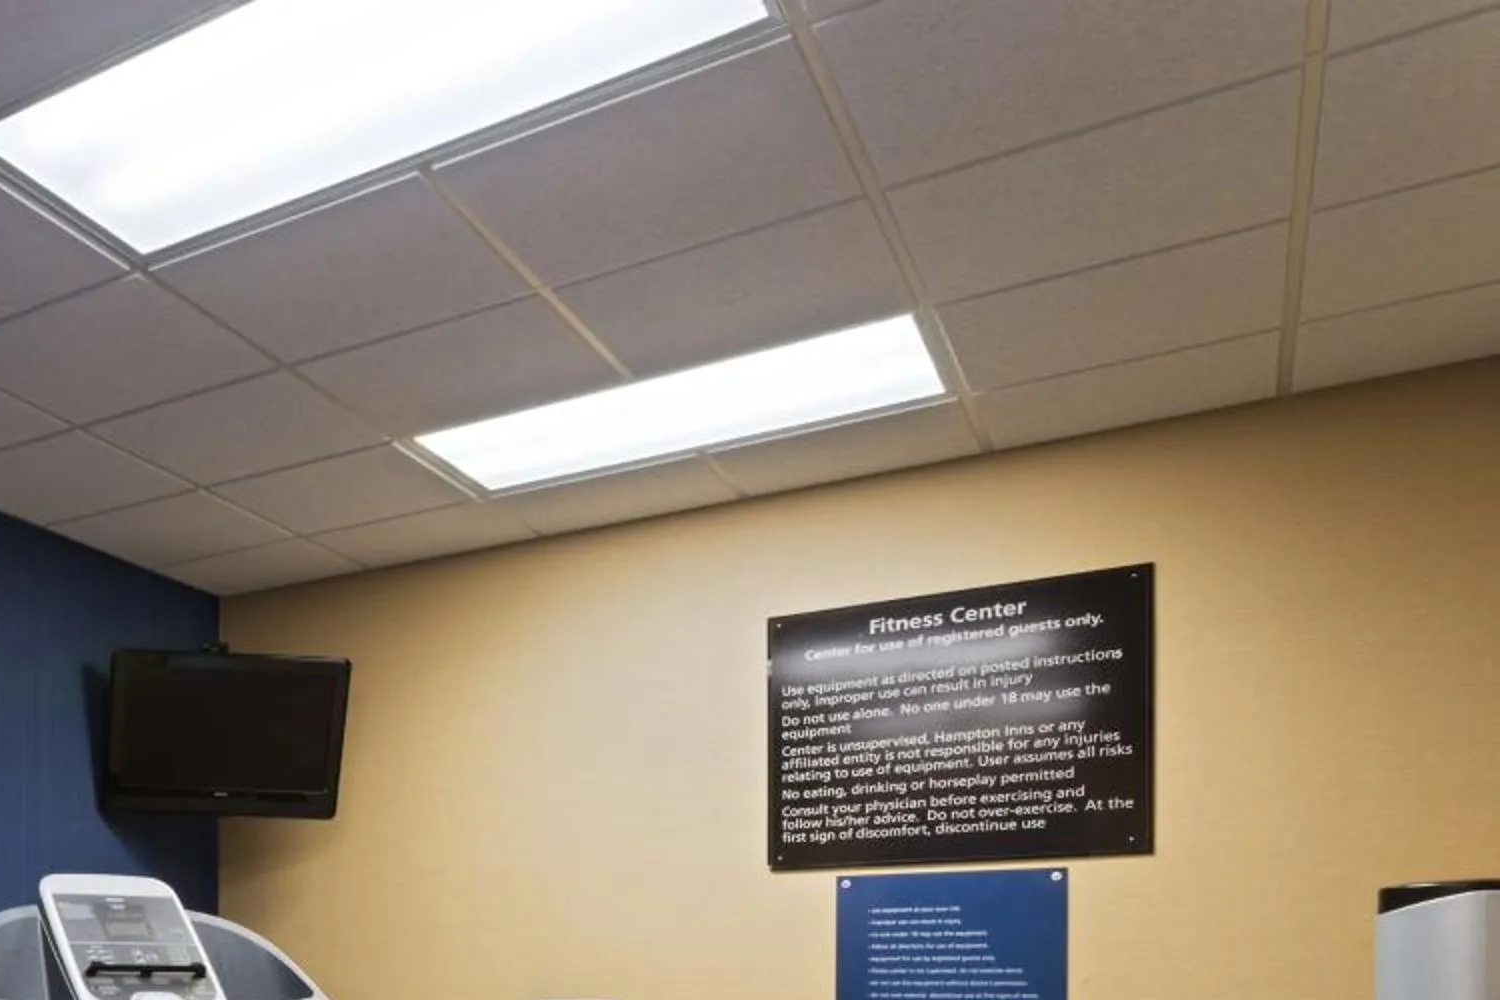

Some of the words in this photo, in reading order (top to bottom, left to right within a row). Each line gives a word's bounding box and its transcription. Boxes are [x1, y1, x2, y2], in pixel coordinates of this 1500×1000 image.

[869, 612, 943, 635] Fitness
[951, 601, 1027, 623] Center
[804, 645, 850, 661] Center
[854, 642, 874, 655] for
[879, 639, 904, 652] use
[907, 634, 924, 648] of
[927, 624, 1004, 646] registered
[1008, 618, 1061, 638] guests
[1064, 612, 1104, 628] only.
[781, 685, 804, 697] Use
[807, 678, 878, 696] equipment
[882, 674, 895, 685] as
[898, 666, 954, 683] directed
[957, 665, 977, 677] on
[980, 657, 1029, 676] posted
[1033, 648, 1123, 668] instructions
[816, 690, 874, 707] improper
[878, 688, 900, 699] use
[903, 684, 926, 697] can
[931, 677, 970, 692] result
[973, 676, 987, 688] in
[990, 672, 1032, 688] injury
[781, 715, 800, 727] Do
[803, 711, 825, 724] not
[829, 710, 849, 722] use
[900, 703, 919, 716] No
[923, 700, 949, 712] one
[953, 695, 996, 709] under
[1001, 691, 1017, 704] 18
[1021, 689, 1051, 703] may
[1055, 686, 1081, 699] use
[1085, 682, 1111, 695] the
[781, 723, 852, 740] equipment
[781, 744, 824, 757] Center
[827, 741, 837, 752] is
[934, 728, 1000, 743] Hampton
[1005, 724, 1034, 736] Inns
[1037, 722, 1054, 733] or
[1058, 720, 1086, 735] any
[781, 753, 839, 771] affiliated
[843, 752, 881, 767] entity
[885, 750, 895, 761] is
[898, 747, 921, 760] not
[924, 739, 1004, 759] responsible
[1007, 737, 1030, 750] for
[1033, 736, 1061, 749] any
[1064, 730, 1121, 747] injuries
[781, 768, 831, 783] relating
[834, 767, 849, 779] to
[851, 766, 874, 777] use
[876, 763, 891, 775] of
[978, 754, 1010, 767] User
[1013, 750, 1074, 764] assumes
[1077, 745, 1094, 758] all
[1099, 743, 1133, 757] risks
[781, 788, 800, 800] No
[851, 779, 907, 796] drinking
[910, 779, 925, 791] or
[929, 773, 997, 789] horseplay
[1000, 766, 1075, 786] permitted
[781, 803, 829, 817] Consult
[832, 803, 861, 818] your
[865, 796, 927, 813] physician
[930, 791, 977, 807] before
[979, 787, 1052, 802] exercising
[1056, 784, 1085, 798] and
[781, 817, 822, 831] follow
[825, 814, 869, 828] his/her
[927, 809, 947, 821] Do
[951, 806, 976, 819] not
[1084, 799, 1103, 811] At
[1108, 797, 1134, 809] the
[781, 830, 807, 843] first
[809, 828, 835, 845] sign
[838, 828, 852, 840] of
[935, 818, 1017, 834] discontinue
[1021, 818, 1046, 830] use
